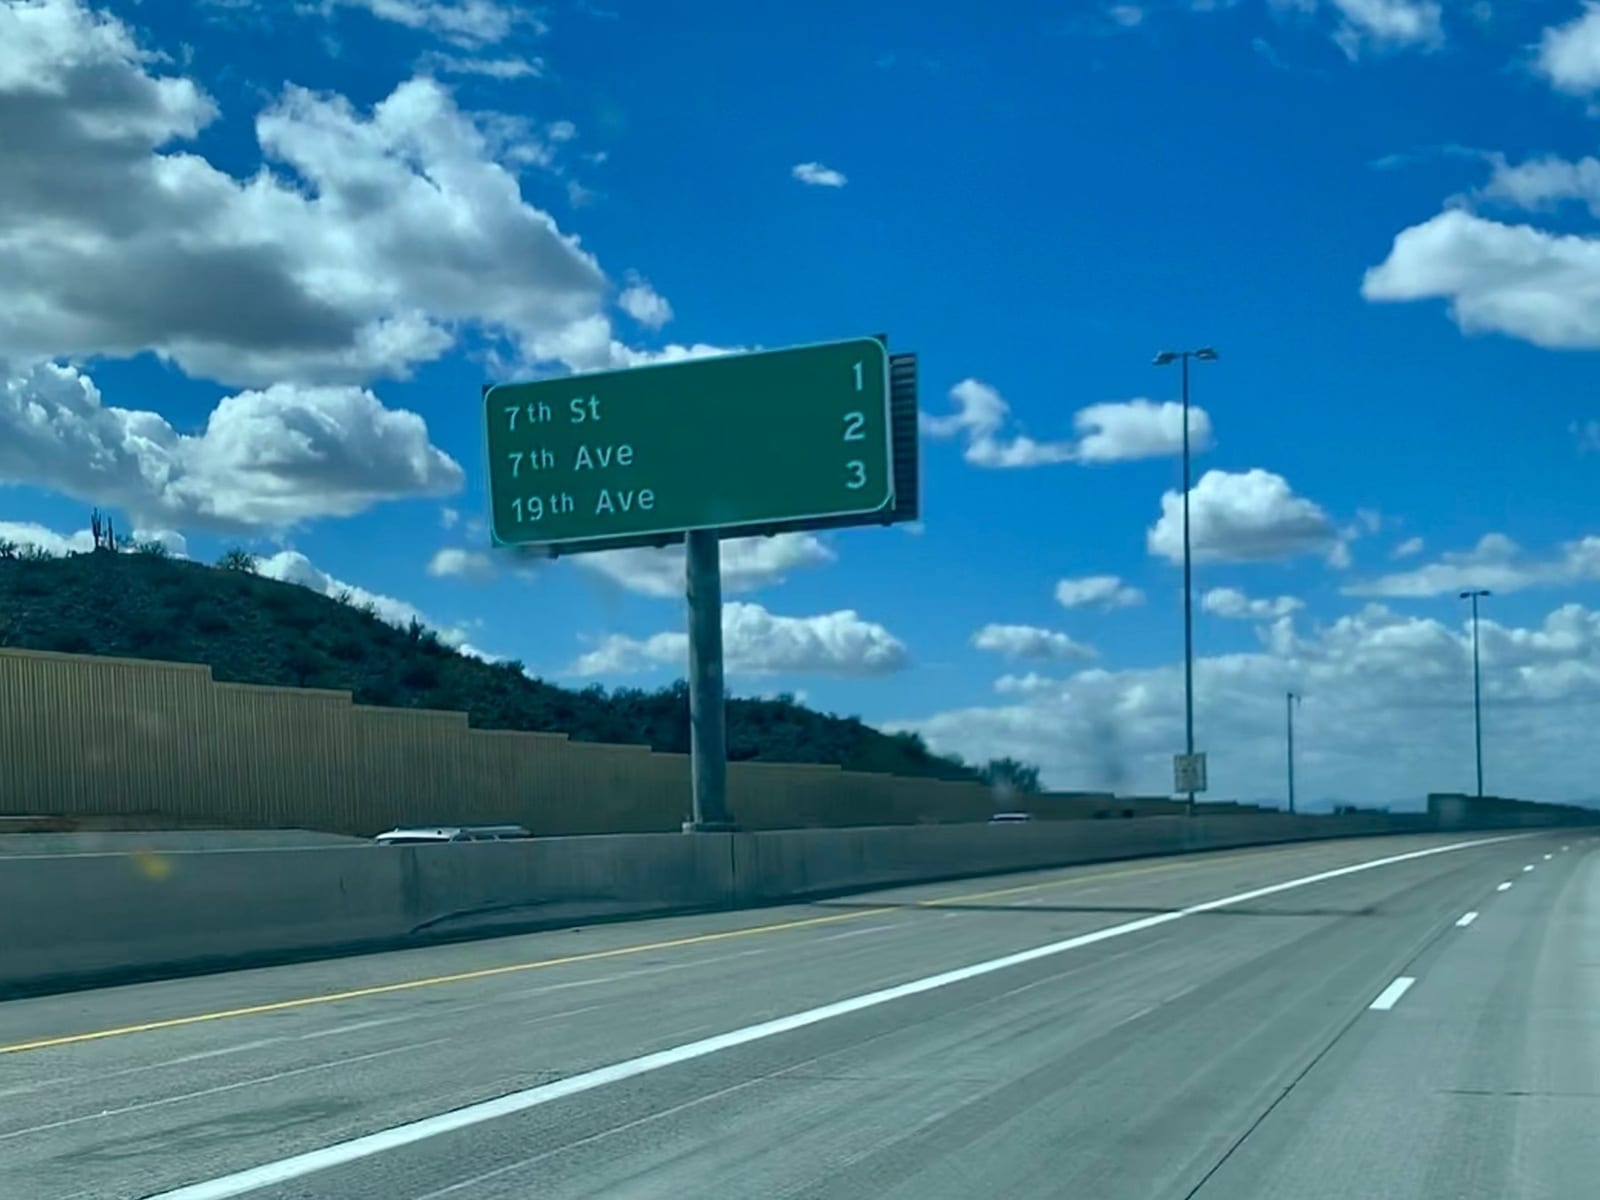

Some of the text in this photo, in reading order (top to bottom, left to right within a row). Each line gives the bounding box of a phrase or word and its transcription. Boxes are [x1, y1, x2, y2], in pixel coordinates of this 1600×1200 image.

[505, 361, 864, 431] 7th St 1
[508, 411, 866, 478] 7th Ave 2
[511, 460, 867, 523] 19th Ave 3
